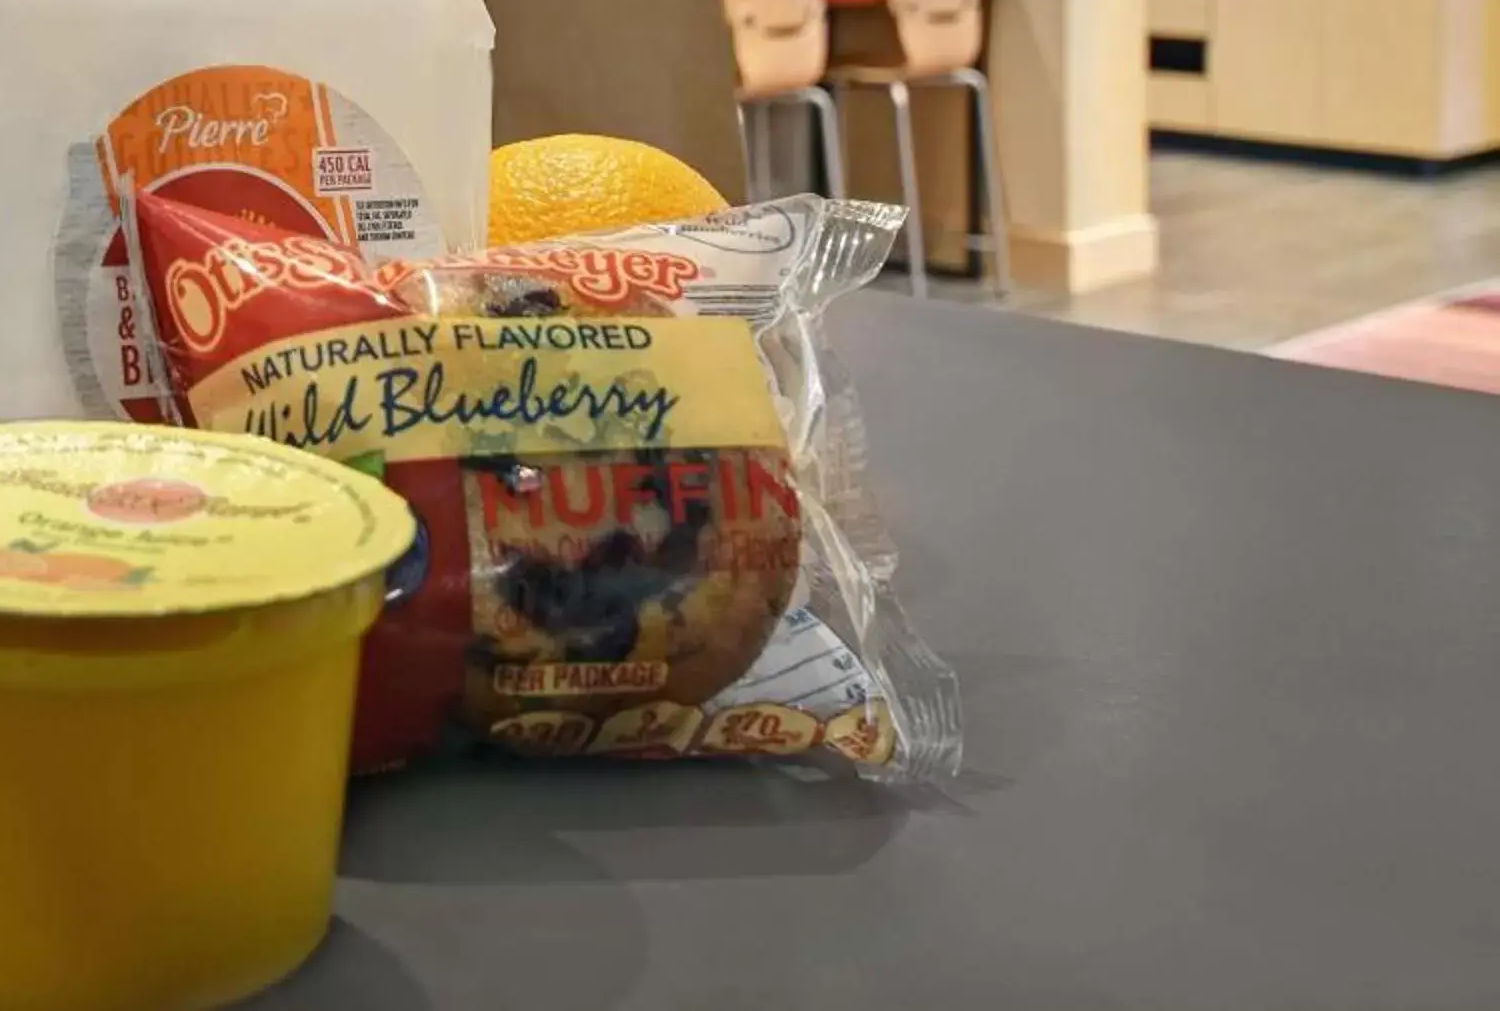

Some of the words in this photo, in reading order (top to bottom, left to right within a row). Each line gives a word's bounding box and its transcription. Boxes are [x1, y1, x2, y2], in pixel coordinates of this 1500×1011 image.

[156, 105, 270, 154] Pierre
[319, 156, 344, 174] 450
[348, 155, 372, 173] CAL
[118, 306, 136, 340] &
[240, 323, 439, 396] NATURALLY
[454, 323, 653, 352] FLAVORED
[378, 356, 680, 440] Blueberry
[476, 456, 800, 533] MUFFIN
[553, 662, 662, 690] PACKAGE
